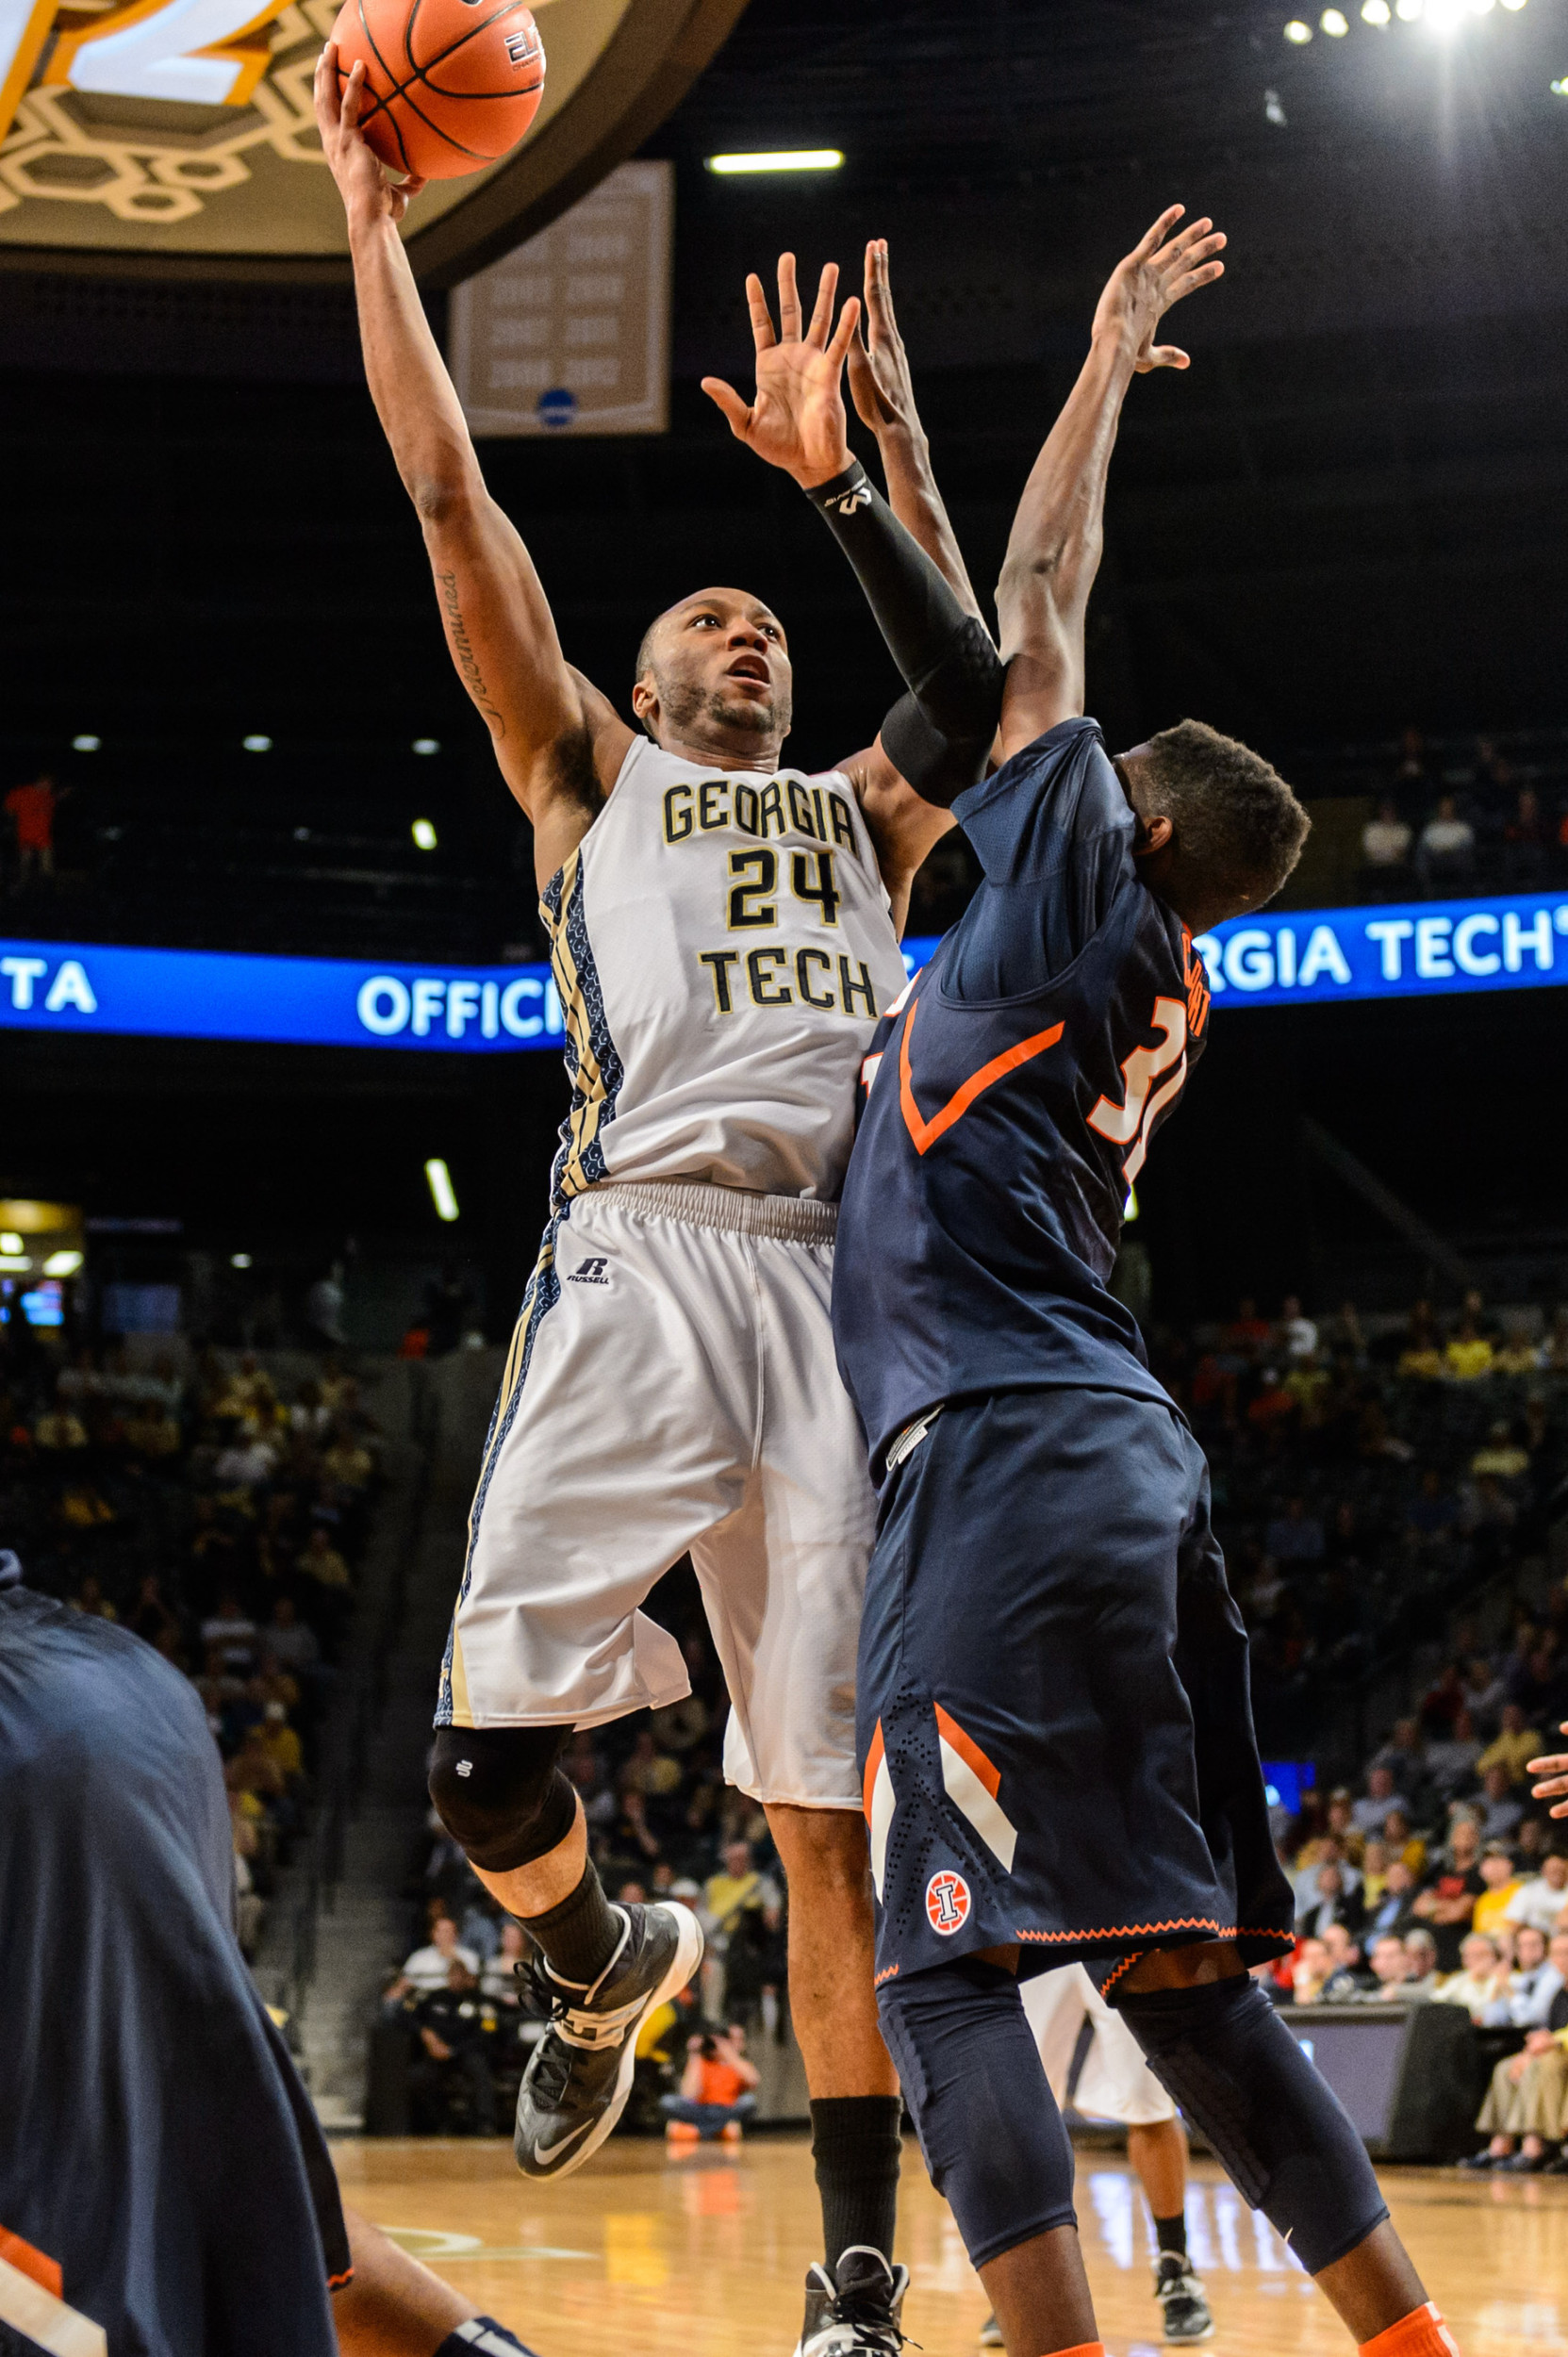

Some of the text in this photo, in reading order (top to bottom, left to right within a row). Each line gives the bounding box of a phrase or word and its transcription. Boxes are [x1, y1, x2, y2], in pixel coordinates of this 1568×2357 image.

[663, 780, 861, 860] GEORGIA
[727, 847, 841, 931] 24
[698, 946, 880, 1020] TECH
[567, 1275, 610, 1285] RUSSELL
